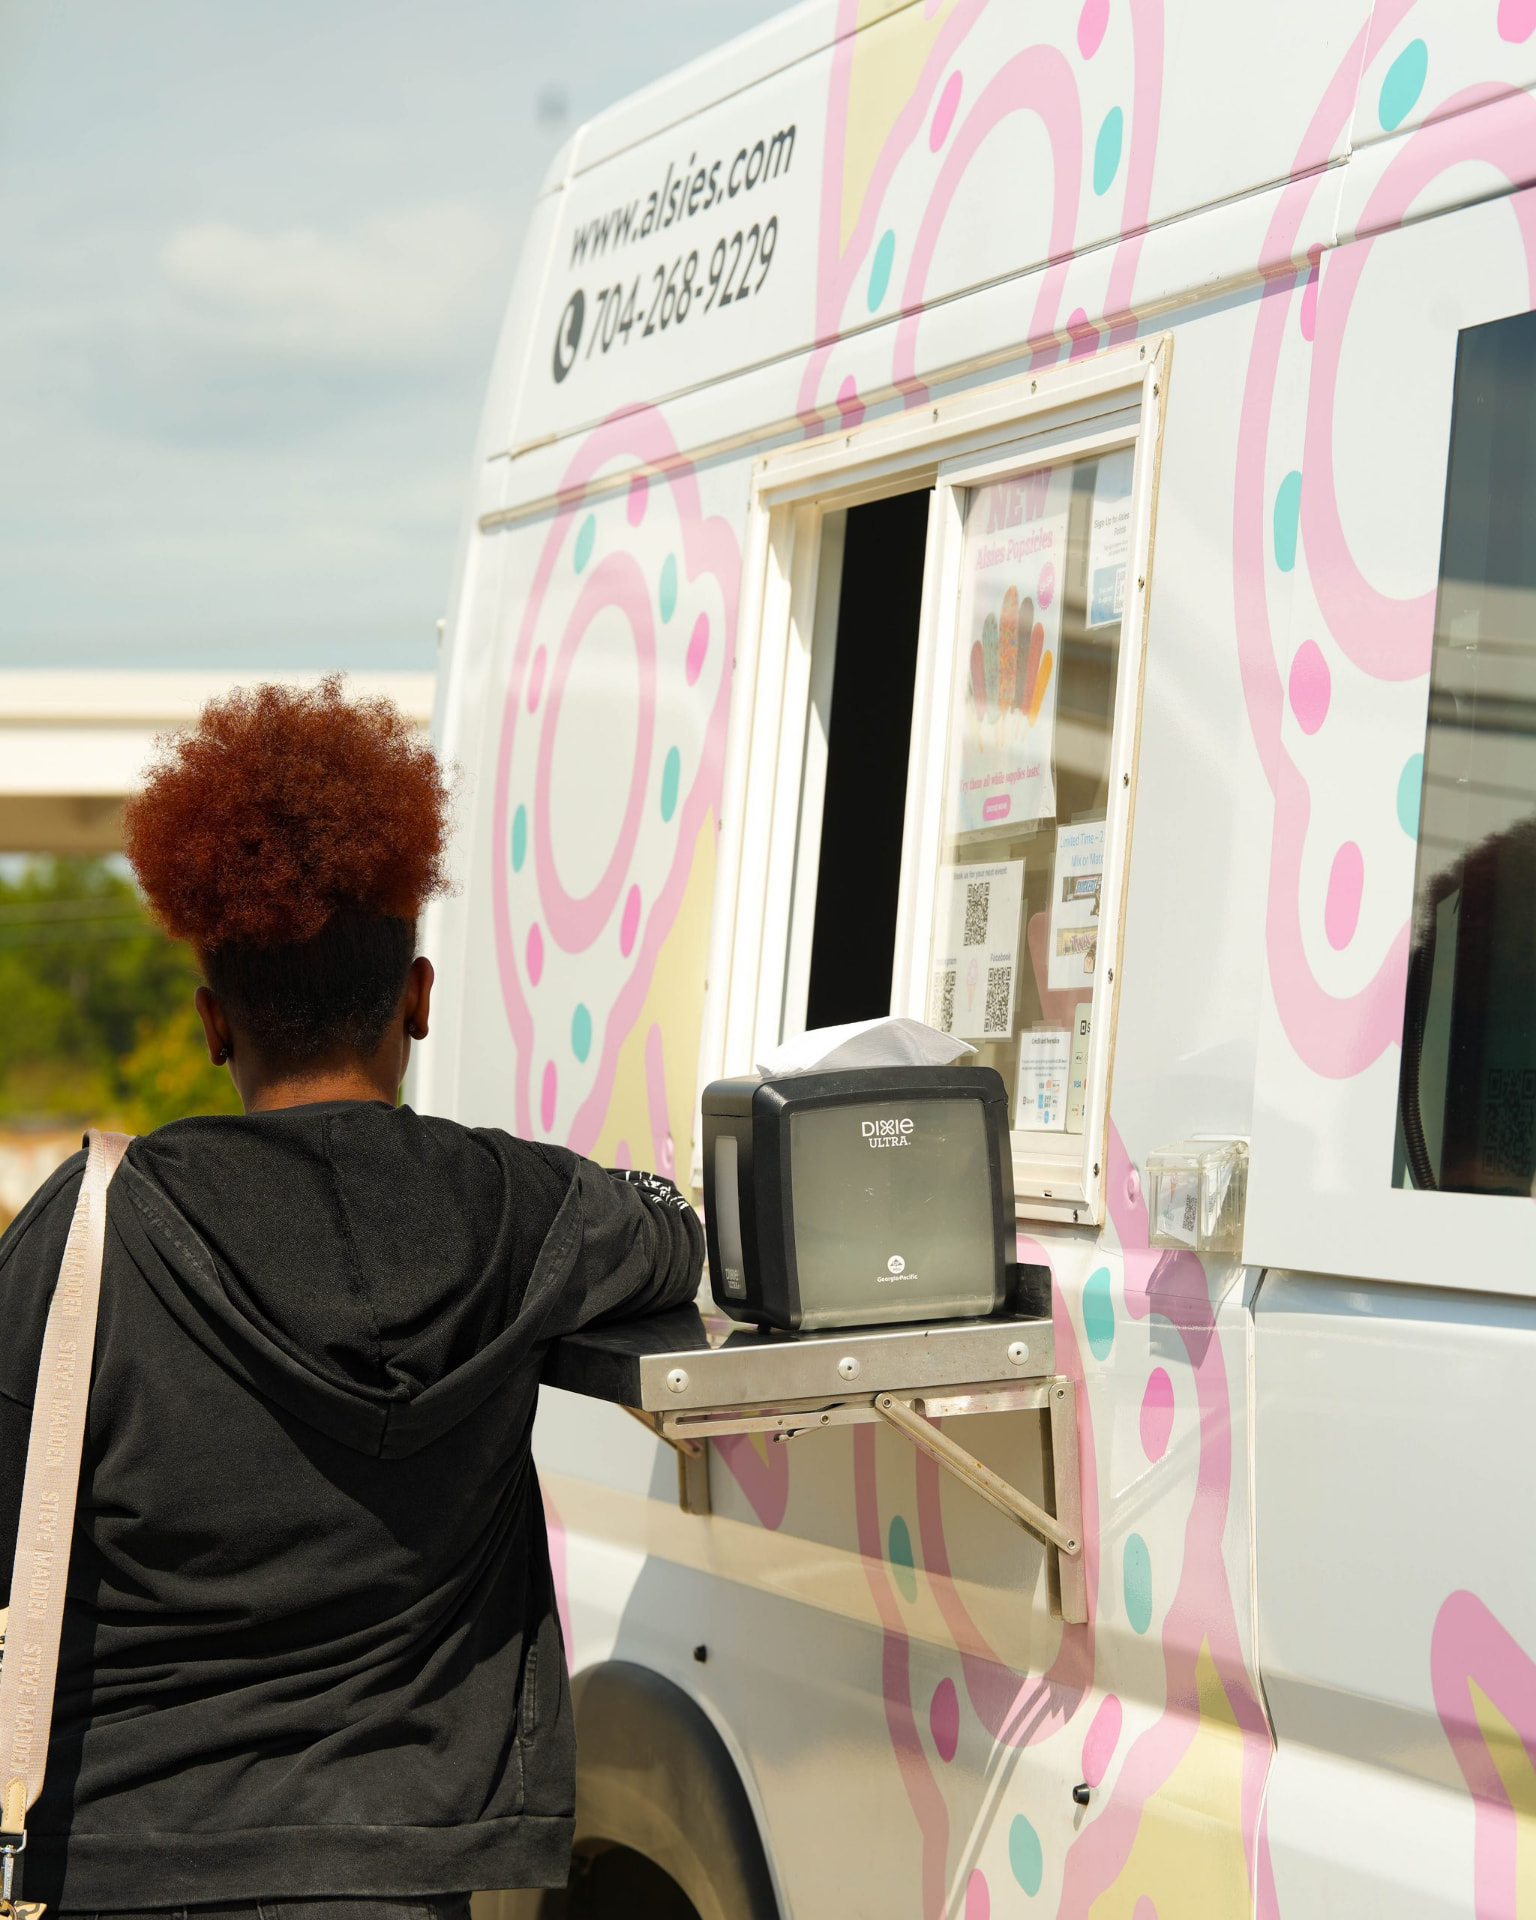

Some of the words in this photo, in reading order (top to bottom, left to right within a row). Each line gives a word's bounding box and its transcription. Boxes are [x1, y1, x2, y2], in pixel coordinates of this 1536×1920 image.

[569, 124, 796, 271] www.alsies.com
[586, 215, 778, 360] 704-268-9229
[986, 467, 1052, 534] NEW
[975, 540, 1006, 571] Alsies
[1006, 527, 1053, 563] Popsicles
[1005, 767, 1026, 784] supplies
[1060, 833, 1080, 848] Limited
[1081, 832, 1094, 845] Time
[1072, 855, 1081, 867] Mix
[1082, 856, 1088, 866] or
[990, 953, 1011, 962] Facebook
